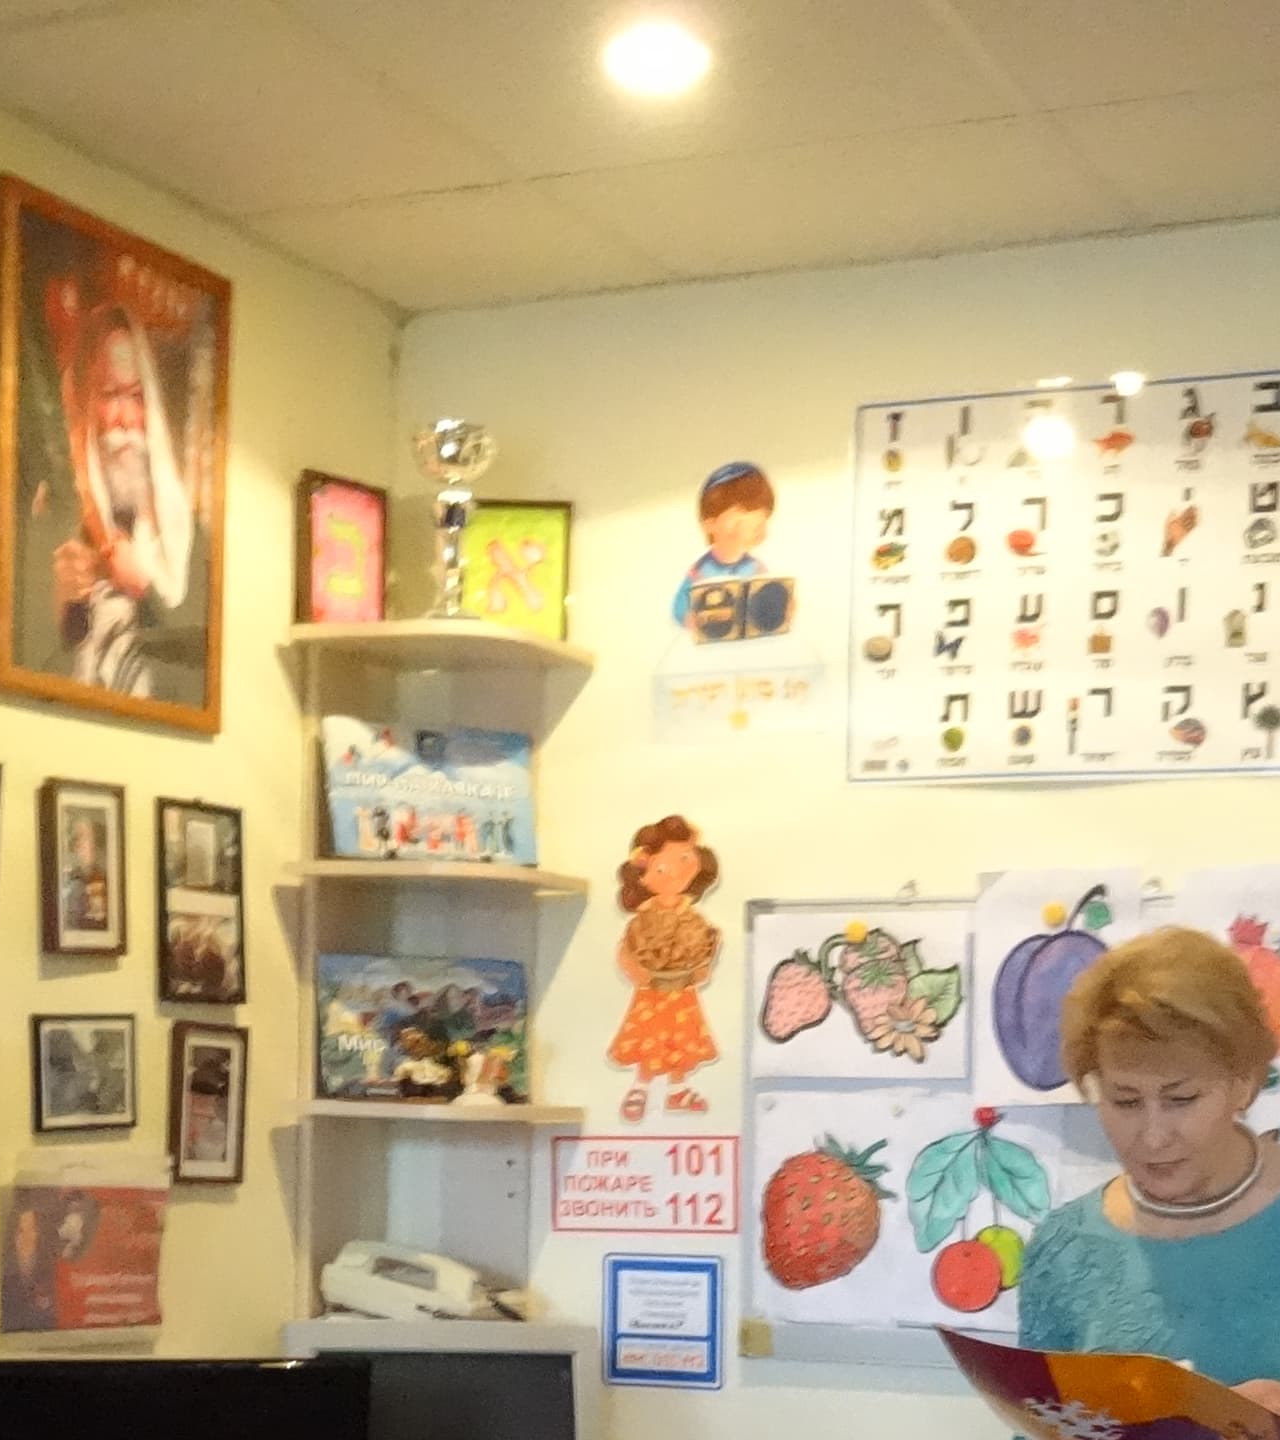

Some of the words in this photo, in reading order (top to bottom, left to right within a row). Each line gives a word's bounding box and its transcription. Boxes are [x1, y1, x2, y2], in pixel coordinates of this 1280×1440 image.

[325, 512, 365, 597] ב
[486, 537, 545, 613] א
[586, 1151, 629, 1168] ПРИ
[665, 1144, 724, 1177] 101
[563, 1174, 654, 1193] ПОЖАРЕ
[559, 1199, 658, 1219] ЗВОНИТЬ
[665, 1192, 724, 1226] 112
